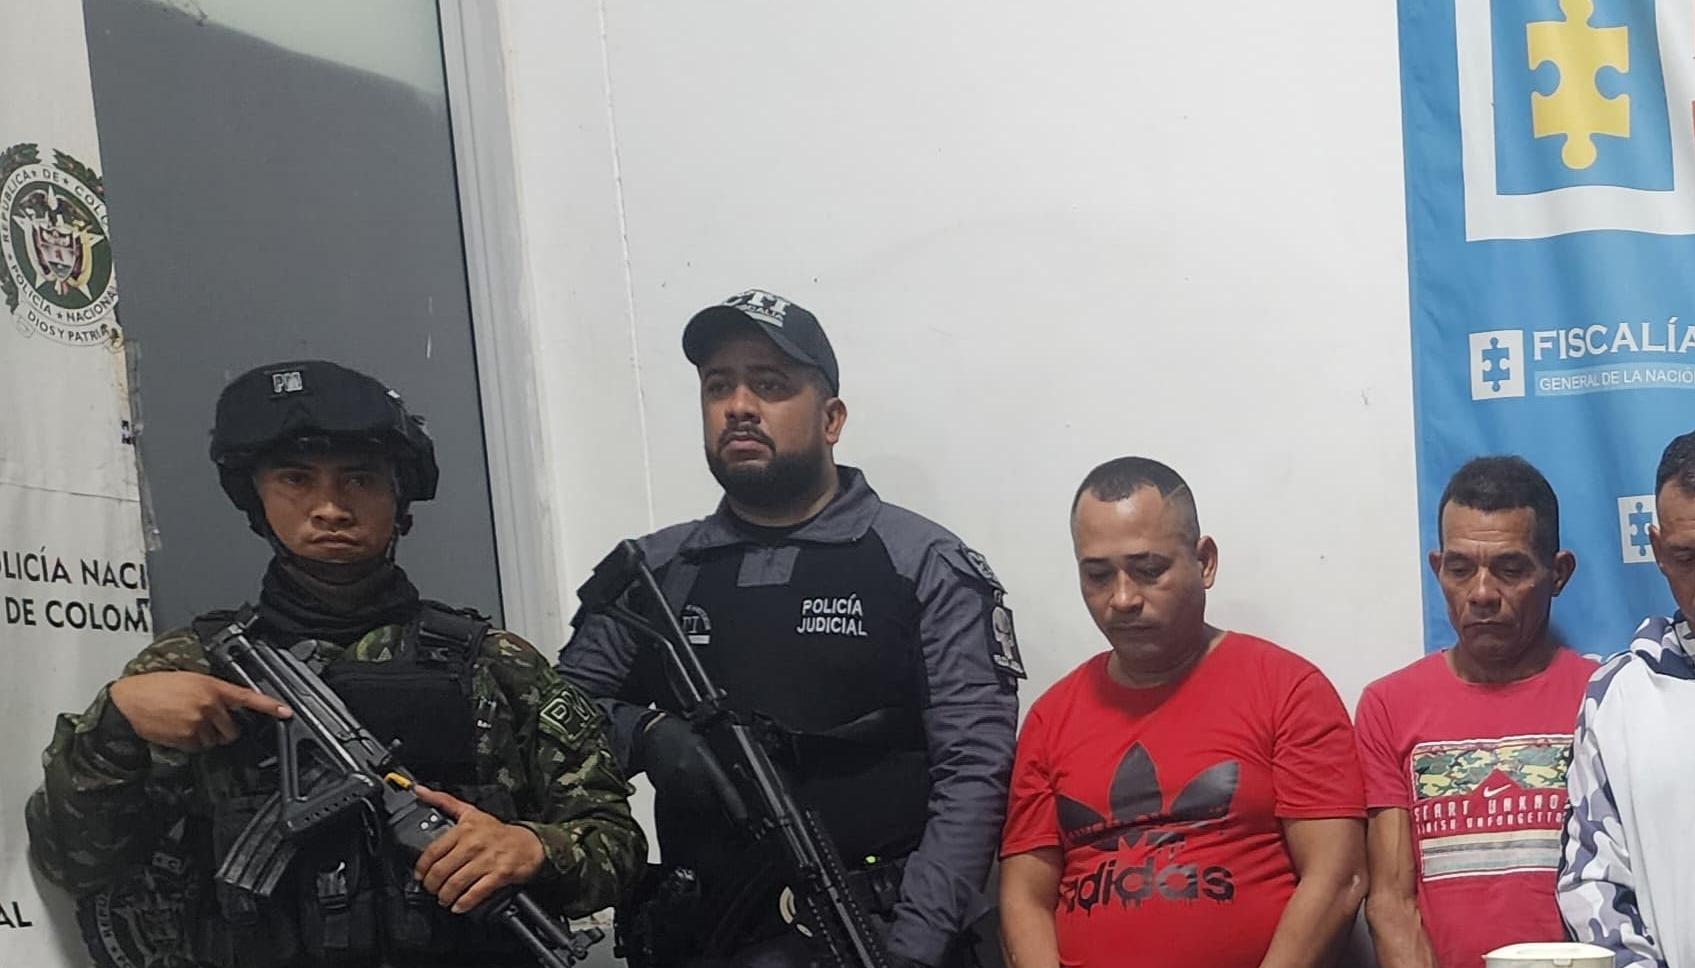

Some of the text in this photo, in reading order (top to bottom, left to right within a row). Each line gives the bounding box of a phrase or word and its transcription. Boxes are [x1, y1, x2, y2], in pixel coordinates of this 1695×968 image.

[1540, 373, 1601, 391] GENERAL
[1602, 371, 1620, 386] DE
[1624, 370, 1642, 383] LA
[0, 545, 72, 584] LICÍA
[5, 596, 36, 626] DE
[802, 593, 864, 617] POLICÍA
[796, 615, 868, 637] JUDICIAL
[1056, 857, 1235, 914] adidas
